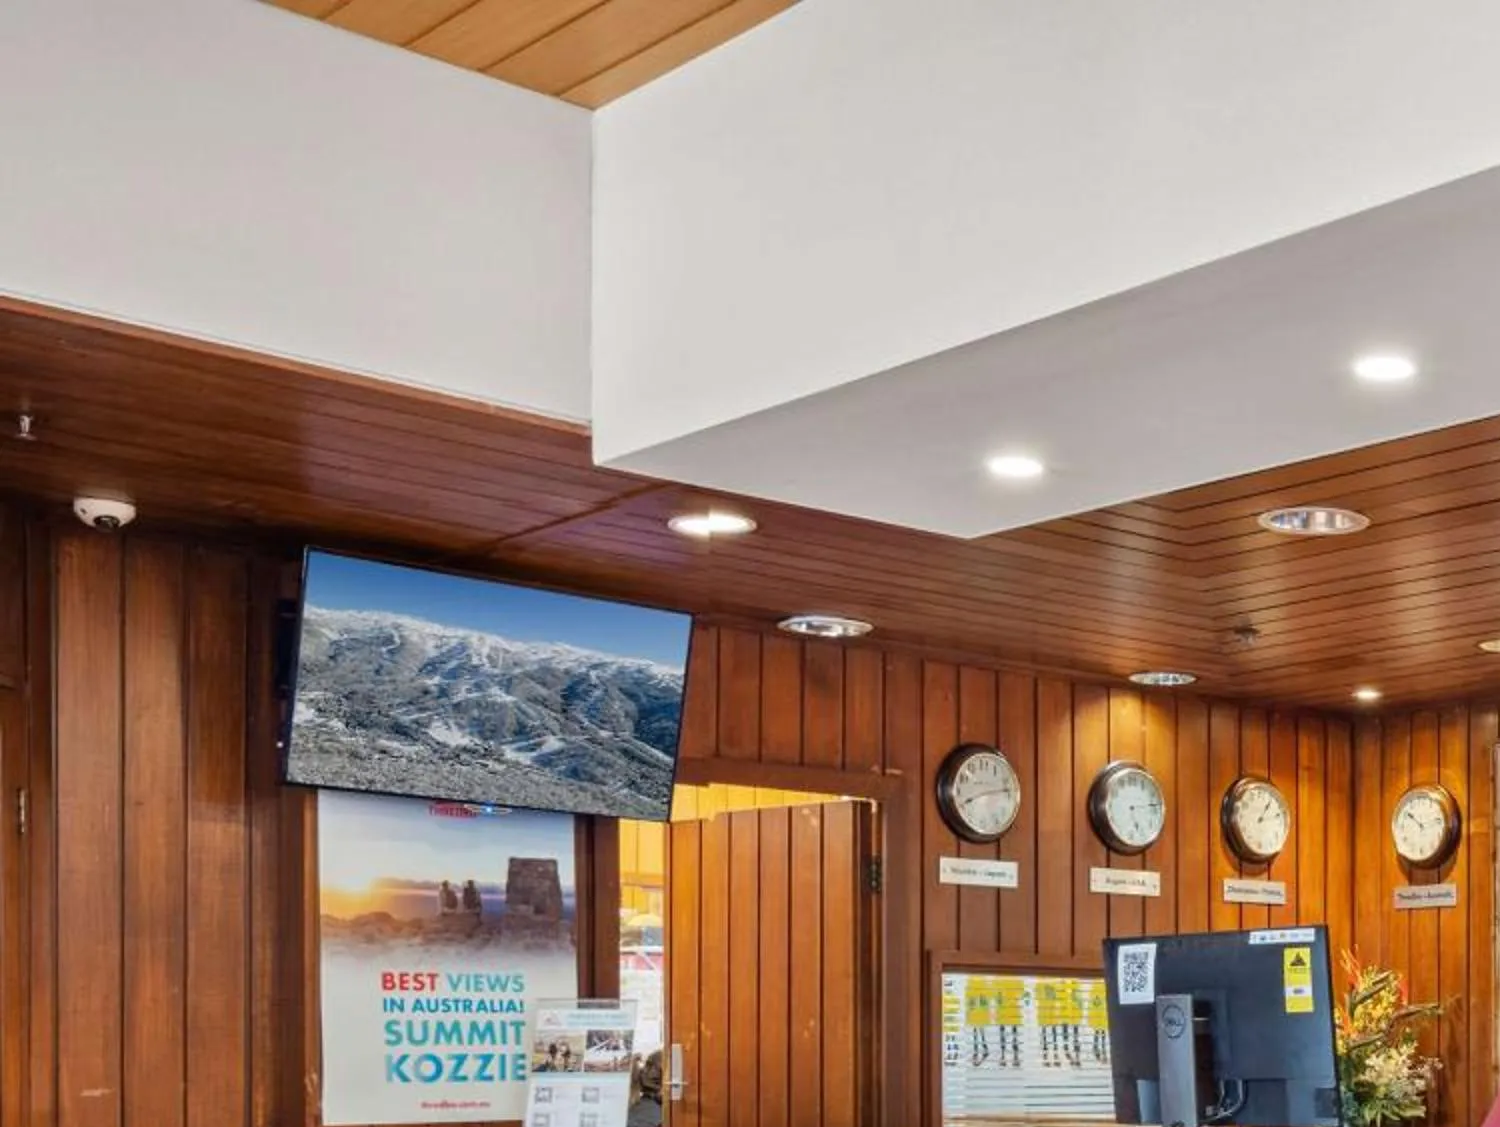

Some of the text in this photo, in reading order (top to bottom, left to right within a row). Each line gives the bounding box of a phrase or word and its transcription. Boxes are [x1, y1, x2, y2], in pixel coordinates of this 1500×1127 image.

[381, 972, 525, 993] BEST VIEWS
[383, 997, 525, 1013] IN AUSTRALIA!
[384, 1018, 526, 1046] SUMMIT
[385, 1053, 527, 1083] KOZZIE
